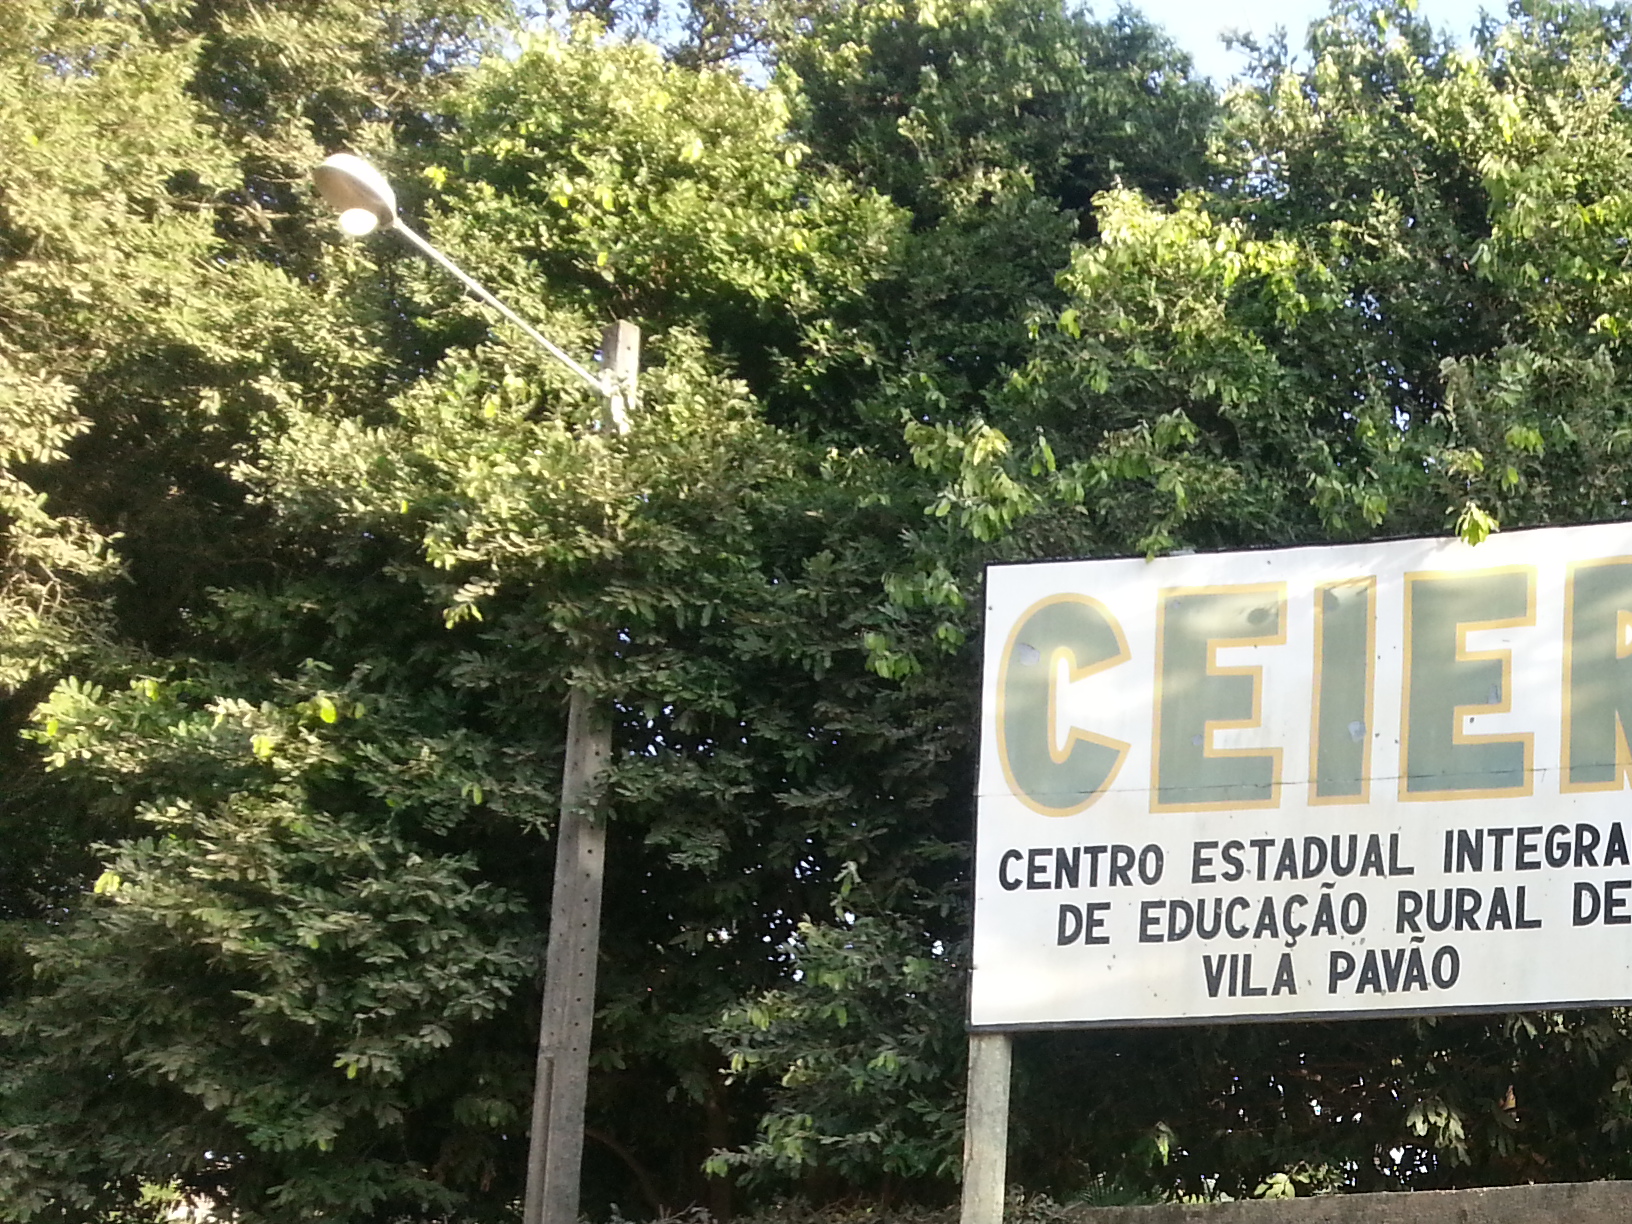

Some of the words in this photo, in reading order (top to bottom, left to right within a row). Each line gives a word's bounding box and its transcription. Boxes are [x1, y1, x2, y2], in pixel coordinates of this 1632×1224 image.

[999, 843, 1165, 891] CENTRO
[1191, 833, 1415, 884] ESTADUAL
[1057, 902, 1112, 946] DE
[1138, 882, 1368, 948] EDUCAÇÃO
[1396, 885, 1542, 933] RURAL
[1572, 879, 1632, 927] DE
[1202, 952, 1298, 998] VILA
[1328, 935, 1461, 995] PAVÃO
